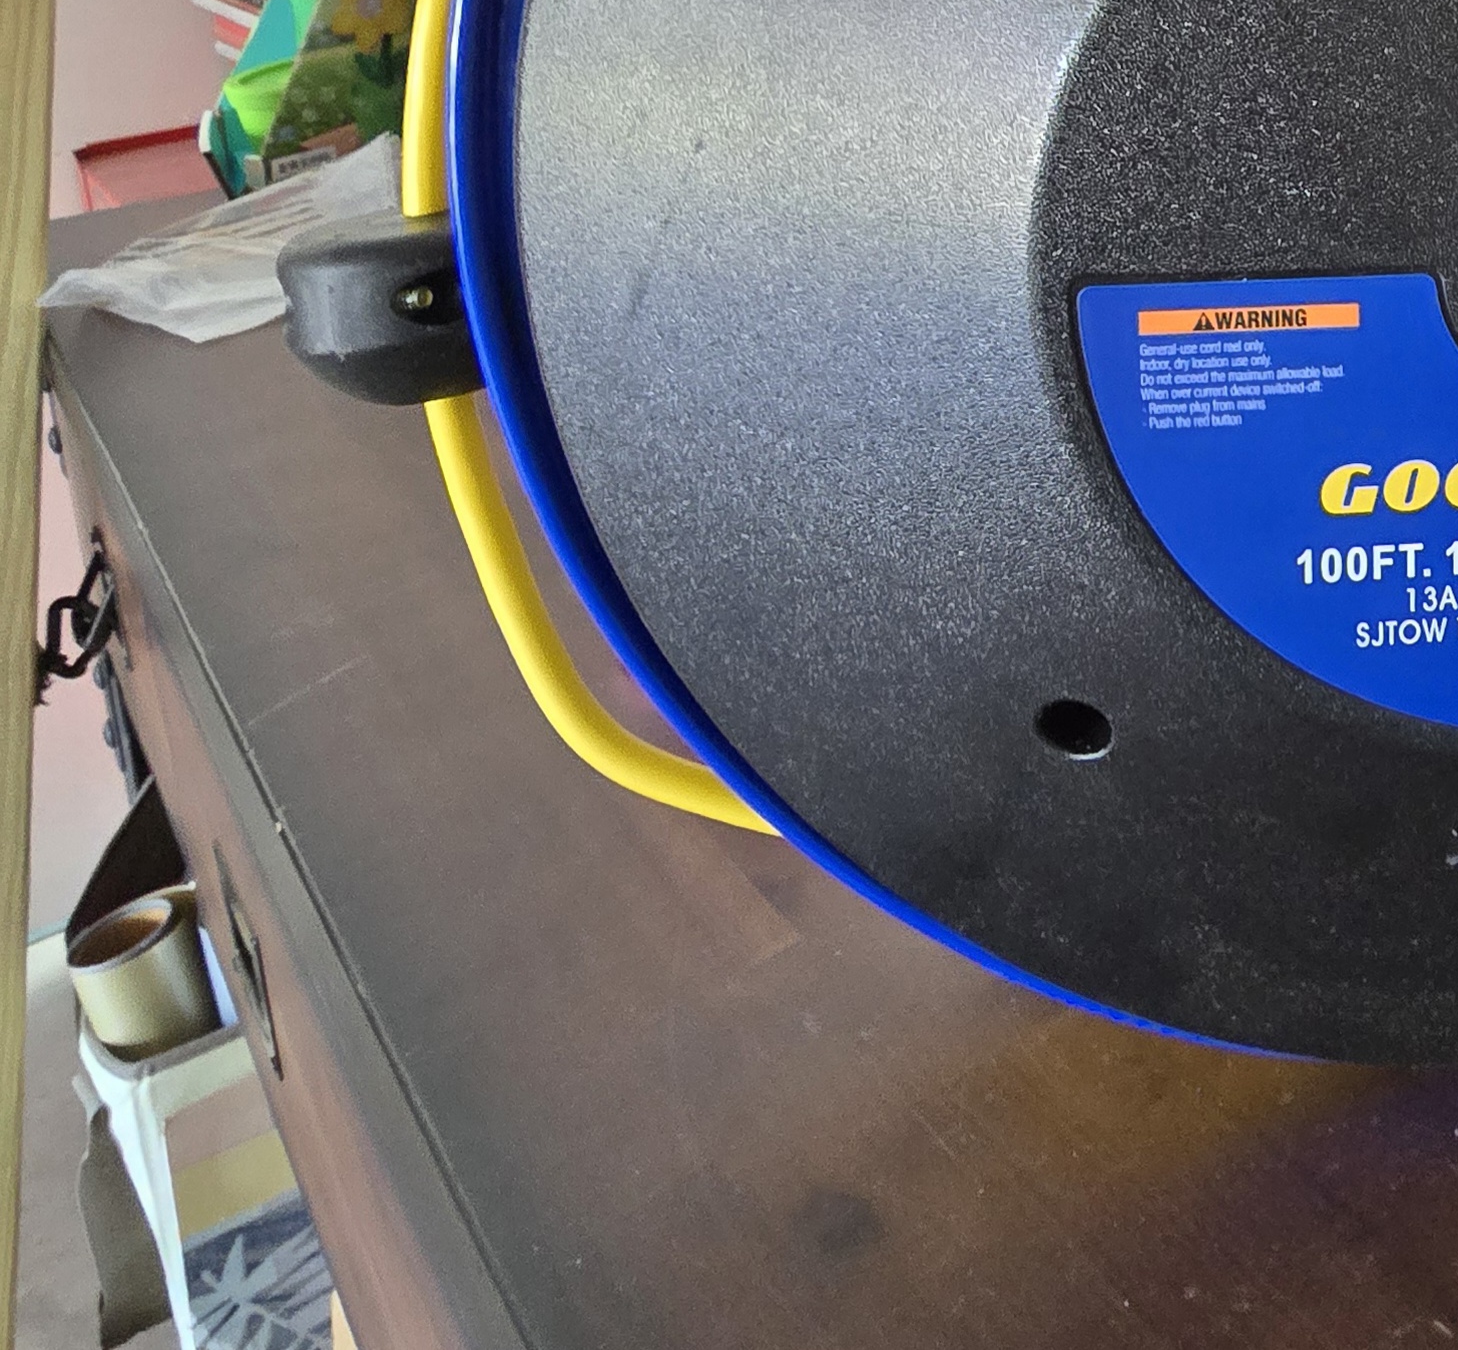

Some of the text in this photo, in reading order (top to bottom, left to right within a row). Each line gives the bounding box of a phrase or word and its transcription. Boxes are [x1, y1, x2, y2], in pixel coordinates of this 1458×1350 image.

[1214, 308, 1307, 330] WARNING
[1200, 341, 1221, 353] cord
[1223, 340, 1242, 352] reel
[1174, 357, 1190, 372] dry
[1191, 356, 1229, 369] location
[1231, 357, 1249, 367] use
[1140, 373, 1154, 386] Do
[1156, 373, 1172, 385] not
[1174, 371, 1209, 384] exceed
[1210, 371, 1226, 382] the
[1228, 370, 1275, 382] maximum
[1276, 366, 1321, 380] allowable
[1140, 388, 1169, 401] When
[1171, 388, 1191, 399] over
[1193, 386, 1228, 398] current
[1230, 384, 1260, 396] device
[1148, 399, 1266, 415] Remove plug from mains
[1149, 415, 1242, 429] Push the red button
[1296, 542, 1432, 585] 100FT.
[1406, 585, 1458, 612] 13A
[1356, 616, 1448, 648] SJTOW
